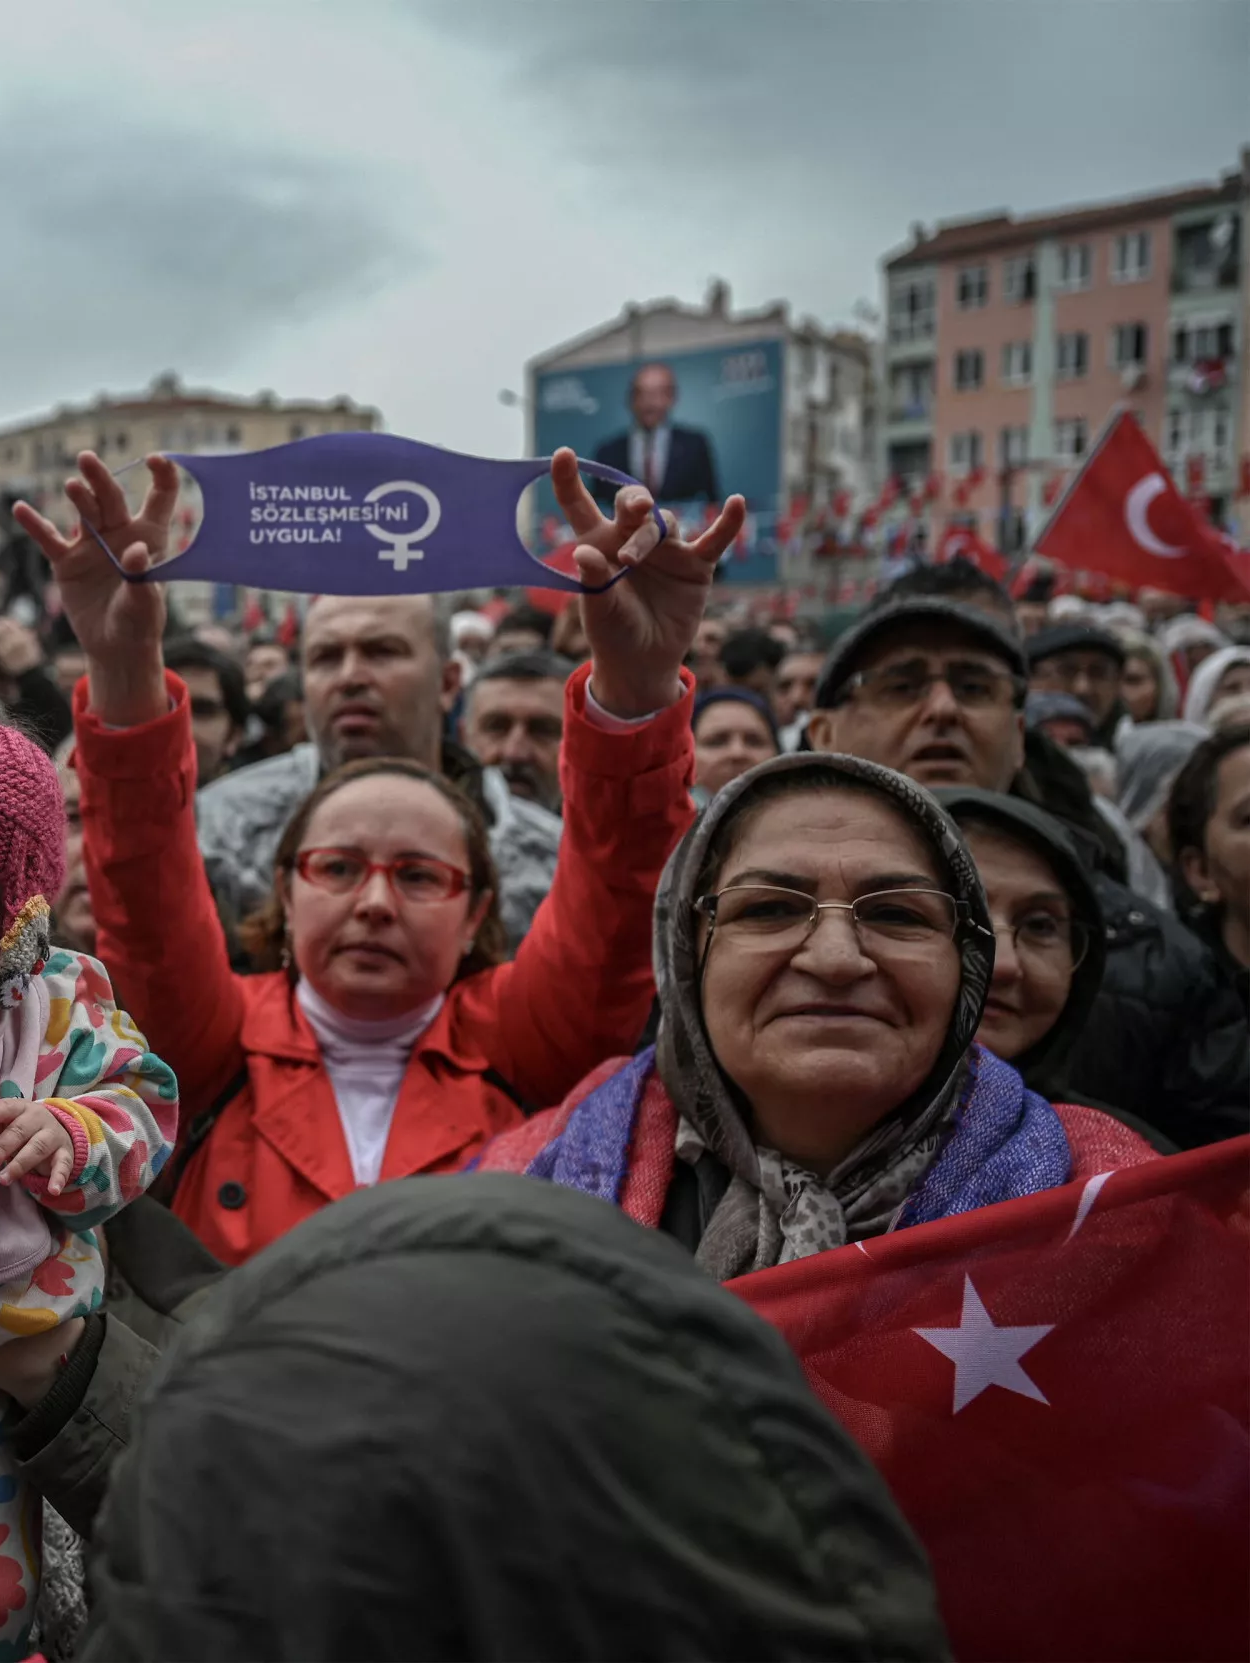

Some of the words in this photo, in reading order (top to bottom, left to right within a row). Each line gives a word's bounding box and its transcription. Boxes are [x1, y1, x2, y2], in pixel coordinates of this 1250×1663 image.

[249, 482, 352, 501] İSTANBUL
[250, 502, 409, 525] SÖZLEŞMESİ'Nİ
[249, 528, 342, 544] UYGULA!
